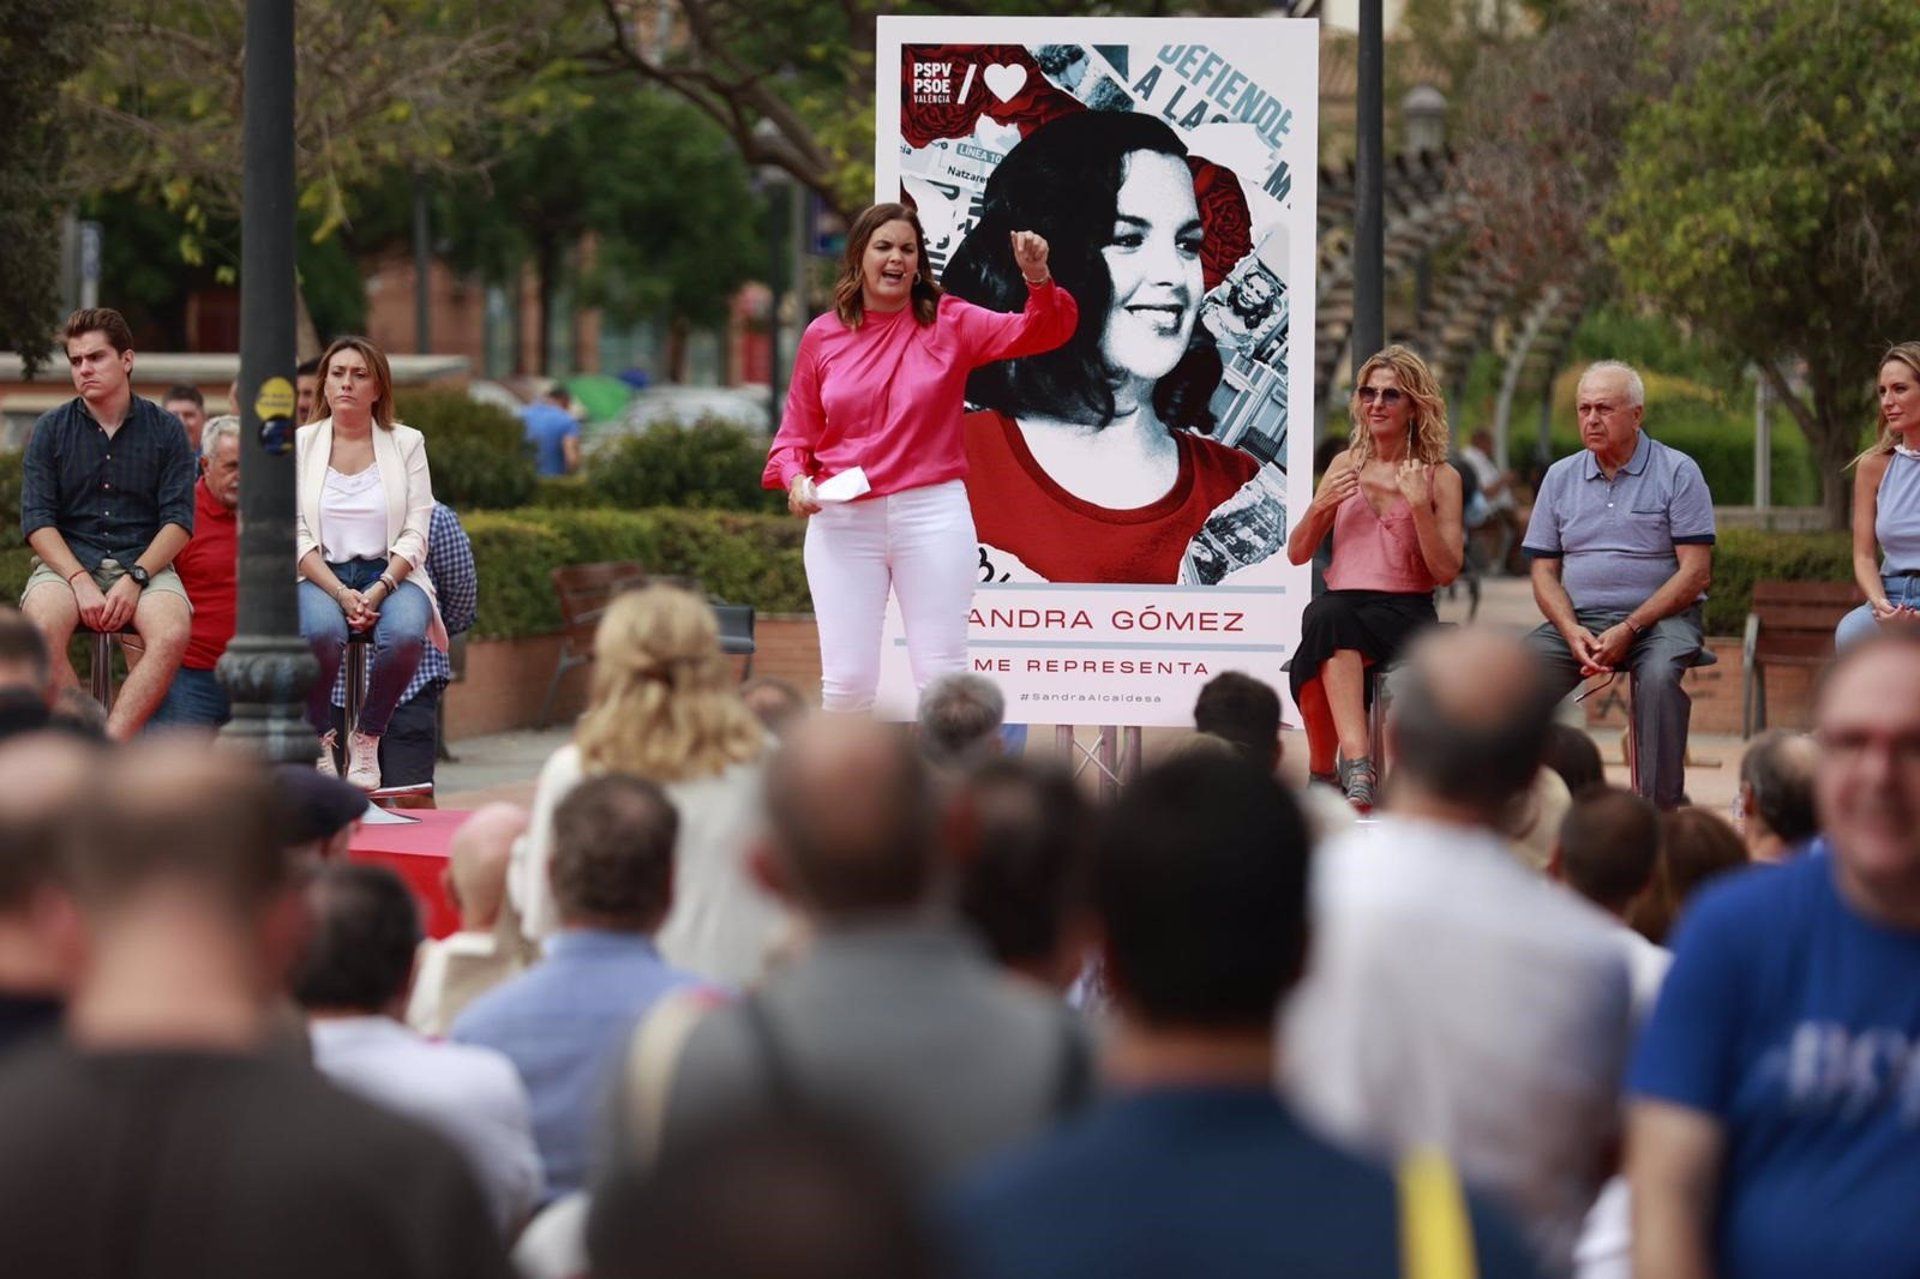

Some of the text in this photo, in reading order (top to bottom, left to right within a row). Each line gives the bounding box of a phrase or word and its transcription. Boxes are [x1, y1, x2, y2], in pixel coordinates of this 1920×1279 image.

[913, 62, 952, 78] PSPV
[913, 79, 951, 93] PSOE
[1132, 65, 1162, 101] A
[947, 165, 989, 184] Natzare
[968, 604, 1244, 631] ANDRA GÓMEZ
[974, 659, 1209, 675] ME REPRESENTA
[1020, 692, 1162, 703] #SandraAlcaldesa
